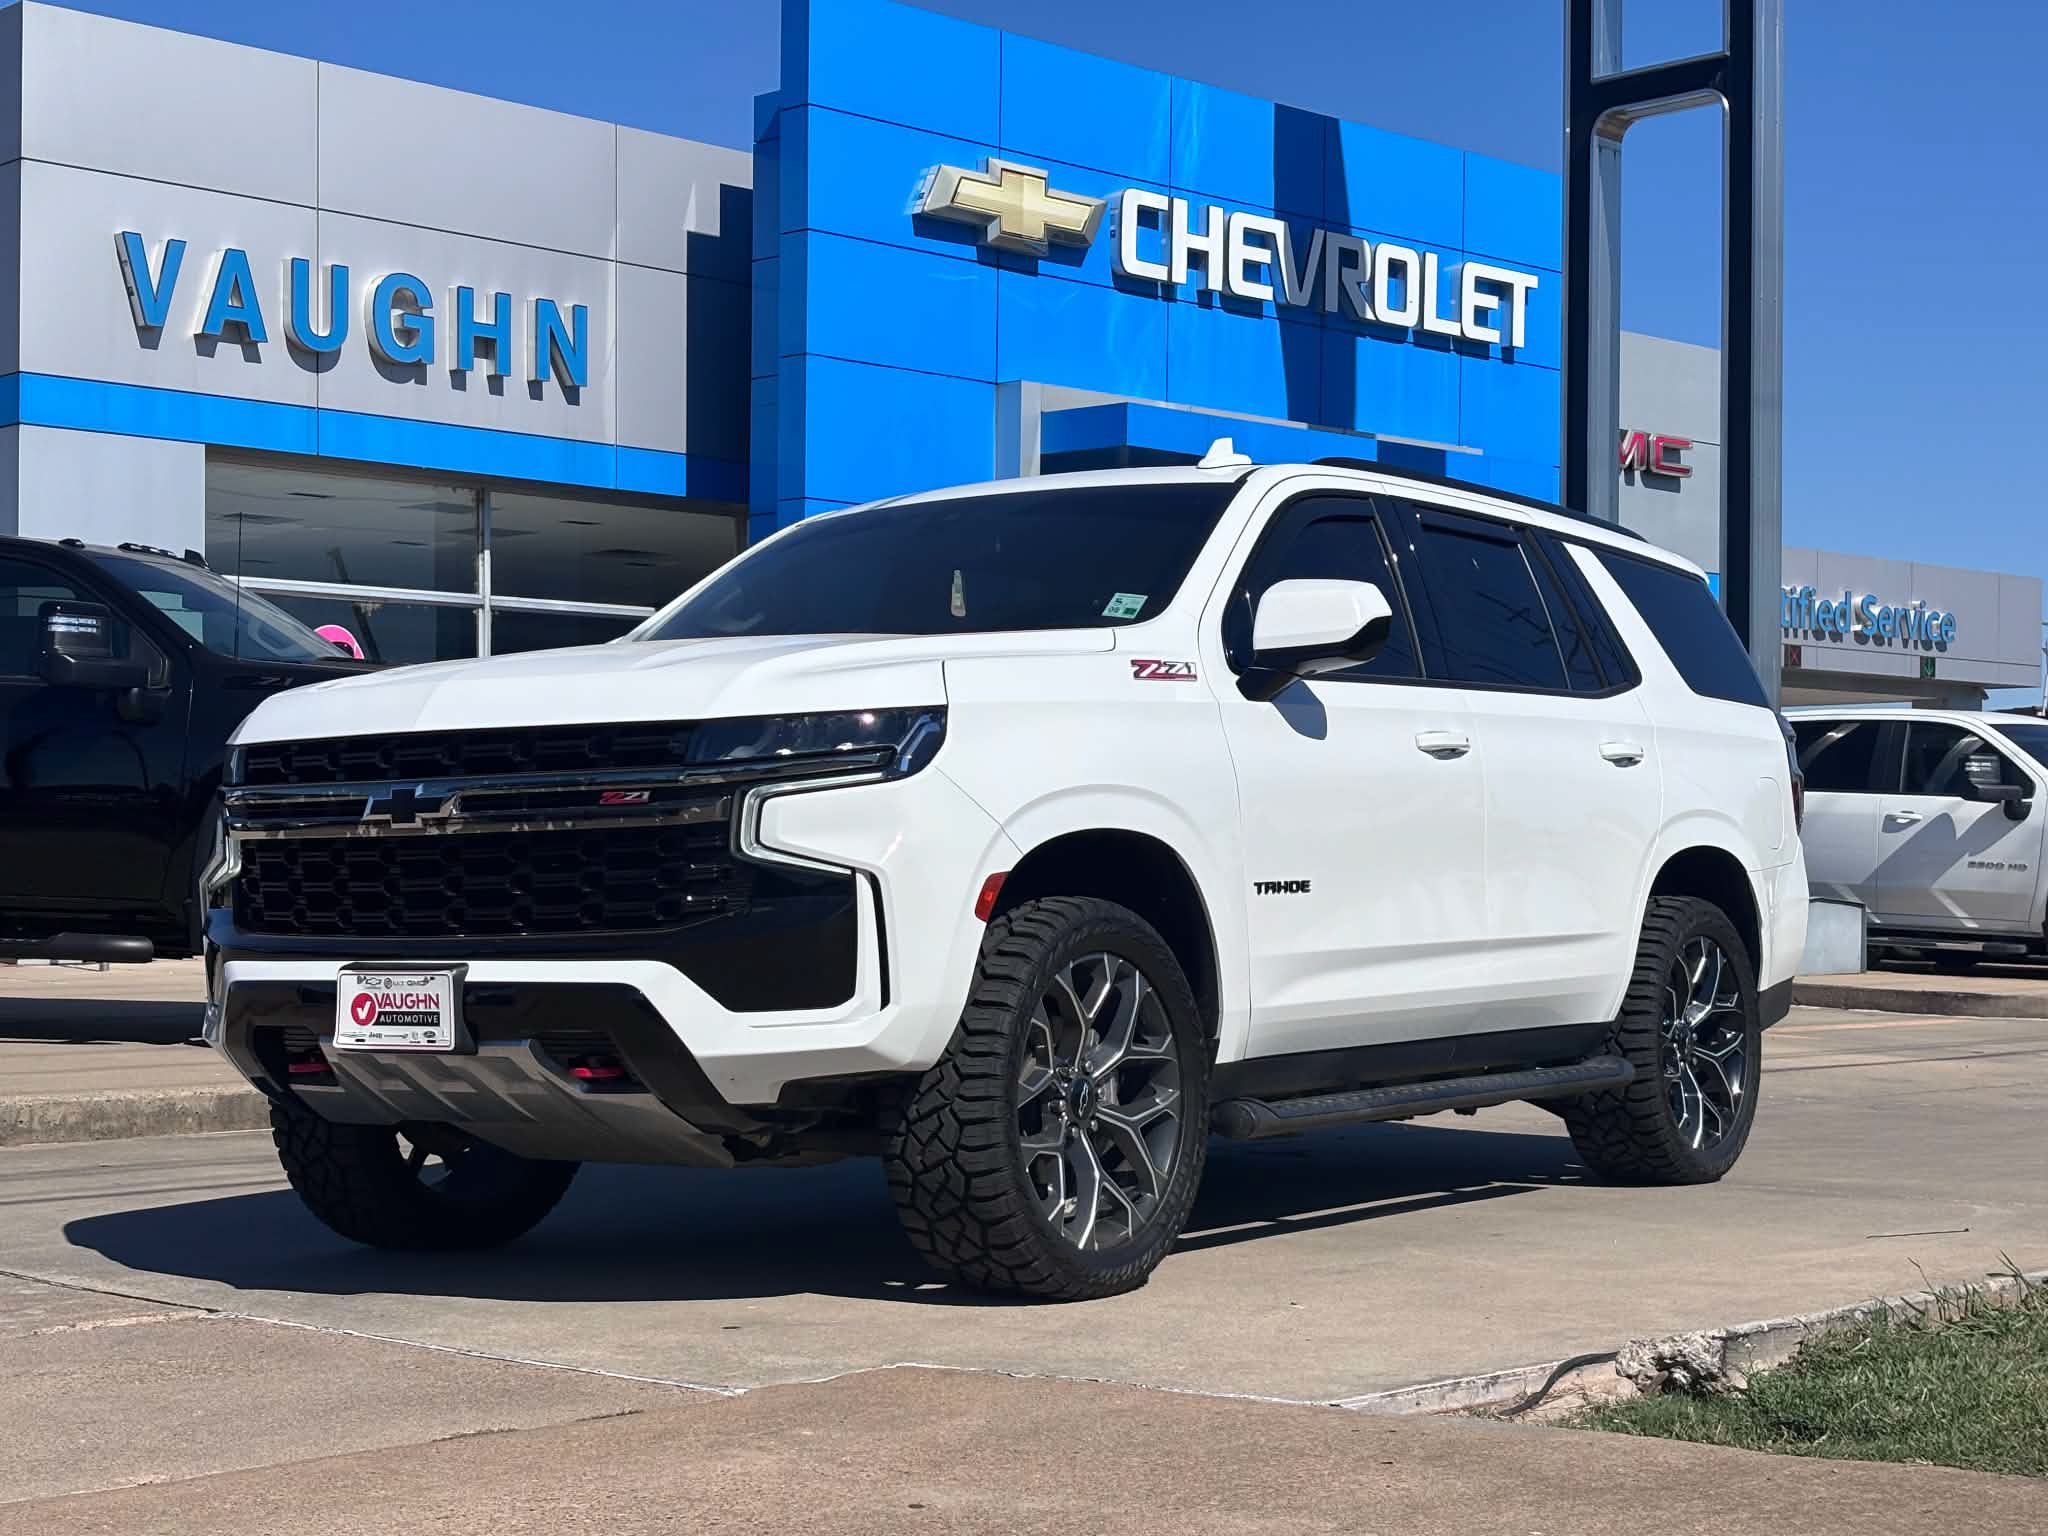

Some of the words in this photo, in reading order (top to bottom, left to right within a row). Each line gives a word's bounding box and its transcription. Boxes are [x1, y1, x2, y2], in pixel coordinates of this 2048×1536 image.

[1112, 188, 1539, 348] CHEVROLET
[114, 231, 588, 388] VAUGHN
[1860, 594, 1957, 643] Service
[1130, 659, 1198, 682] Z71
[600, 791, 650, 805] Z71
[1253, 879, 1312, 896] TAHOE
[374, 992, 440, 1010] VAUGHN
[379, 1014, 439, 1024] AUTOMOTIVE
